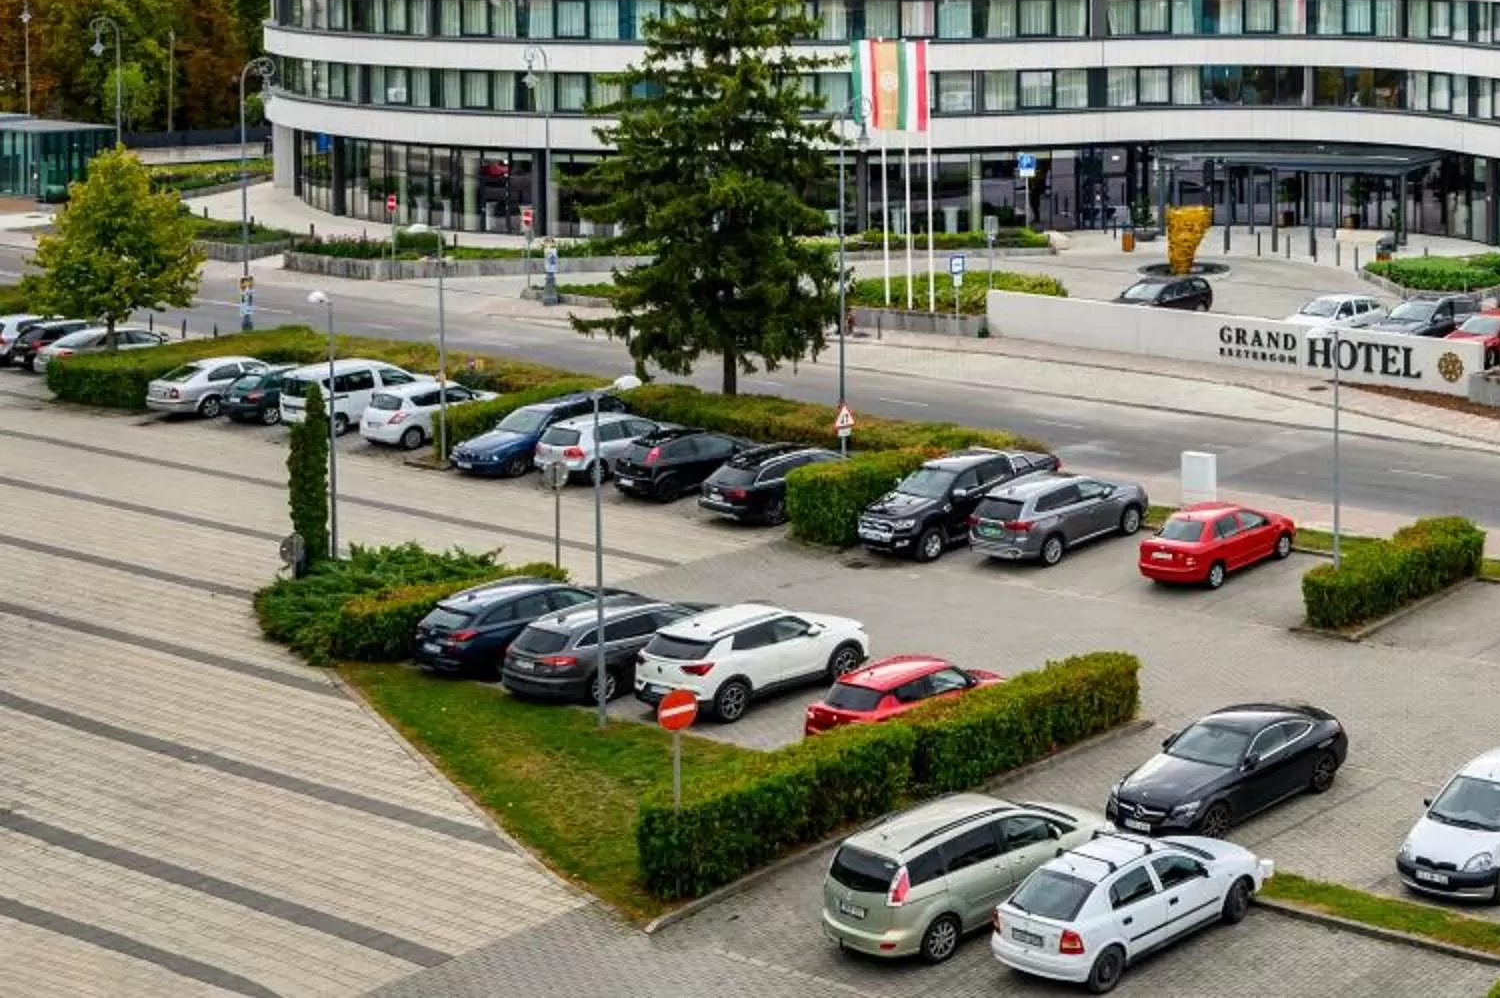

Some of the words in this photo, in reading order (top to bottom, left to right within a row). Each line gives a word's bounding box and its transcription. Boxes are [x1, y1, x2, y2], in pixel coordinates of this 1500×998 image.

[1219, 326, 1297, 351] GRAND
[1307, 337, 1422, 379] HOTEL
[1219, 347, 1297, 365] ESZTERGOM
